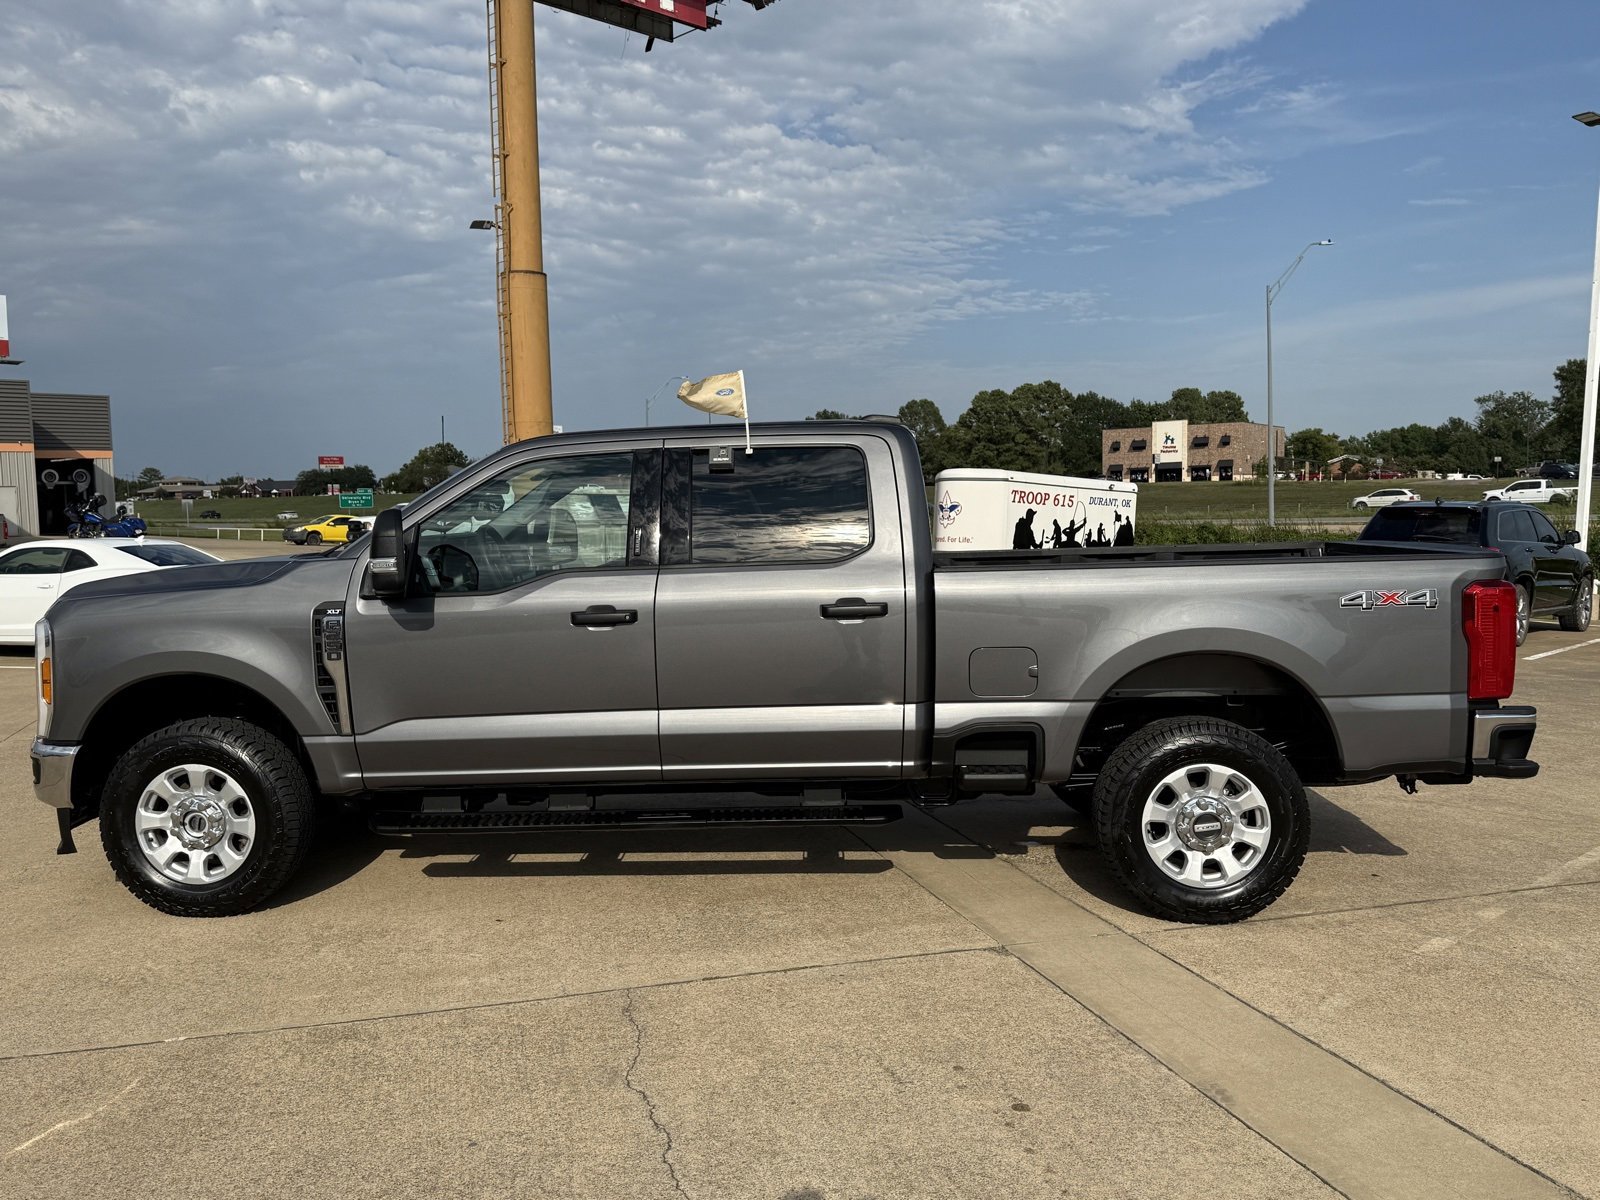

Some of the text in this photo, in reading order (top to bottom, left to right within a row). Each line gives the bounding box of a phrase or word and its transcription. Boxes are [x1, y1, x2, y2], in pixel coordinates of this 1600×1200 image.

[1011, 489, 1075, 508] TROOP 615
[1088, 496, 1132, 508] DURANT, OK
